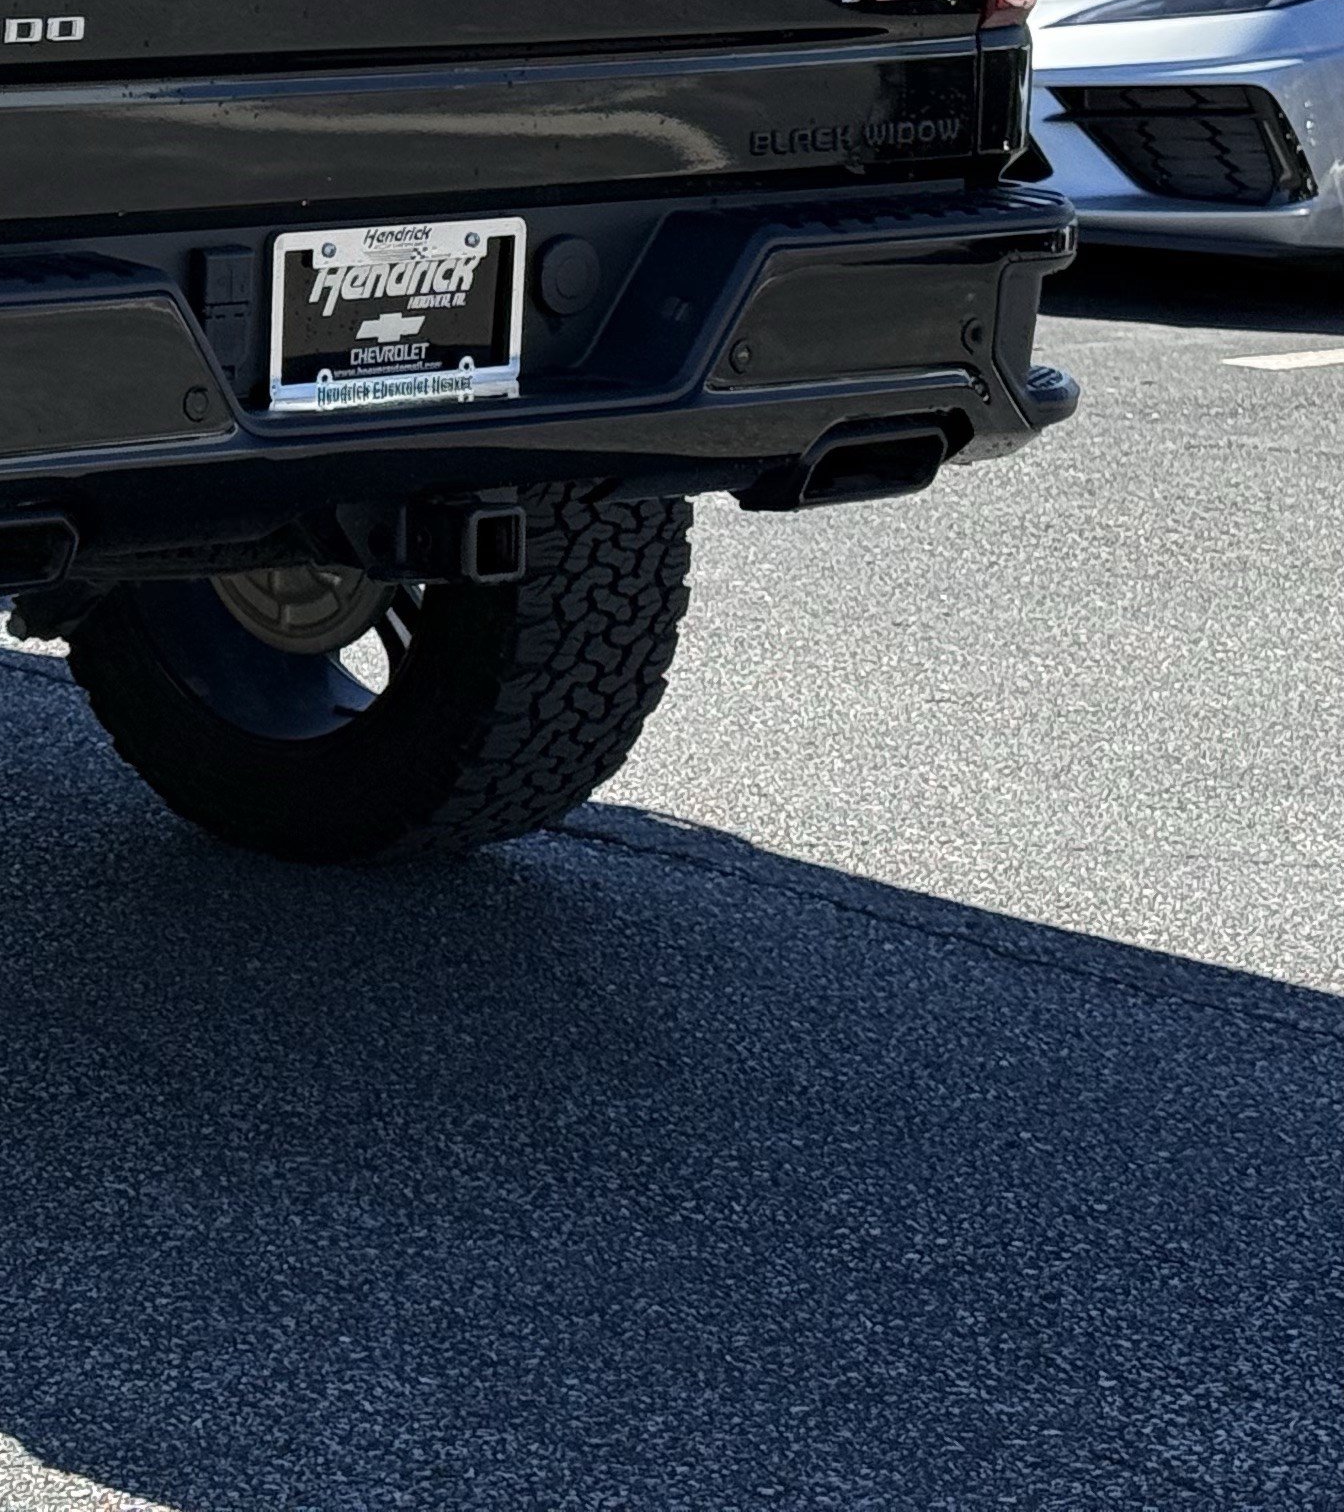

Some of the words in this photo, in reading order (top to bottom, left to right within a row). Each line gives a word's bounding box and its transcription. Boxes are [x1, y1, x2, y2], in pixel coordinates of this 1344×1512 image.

[749, 123, 853, 156] BLACK
[864, 118, 960, 147] WIDOW
[363, 225, 433, 249] Hendrick
[308, 255, 482, 317] Hendrick
[350, 342, 430, 366] CHEVROLET
